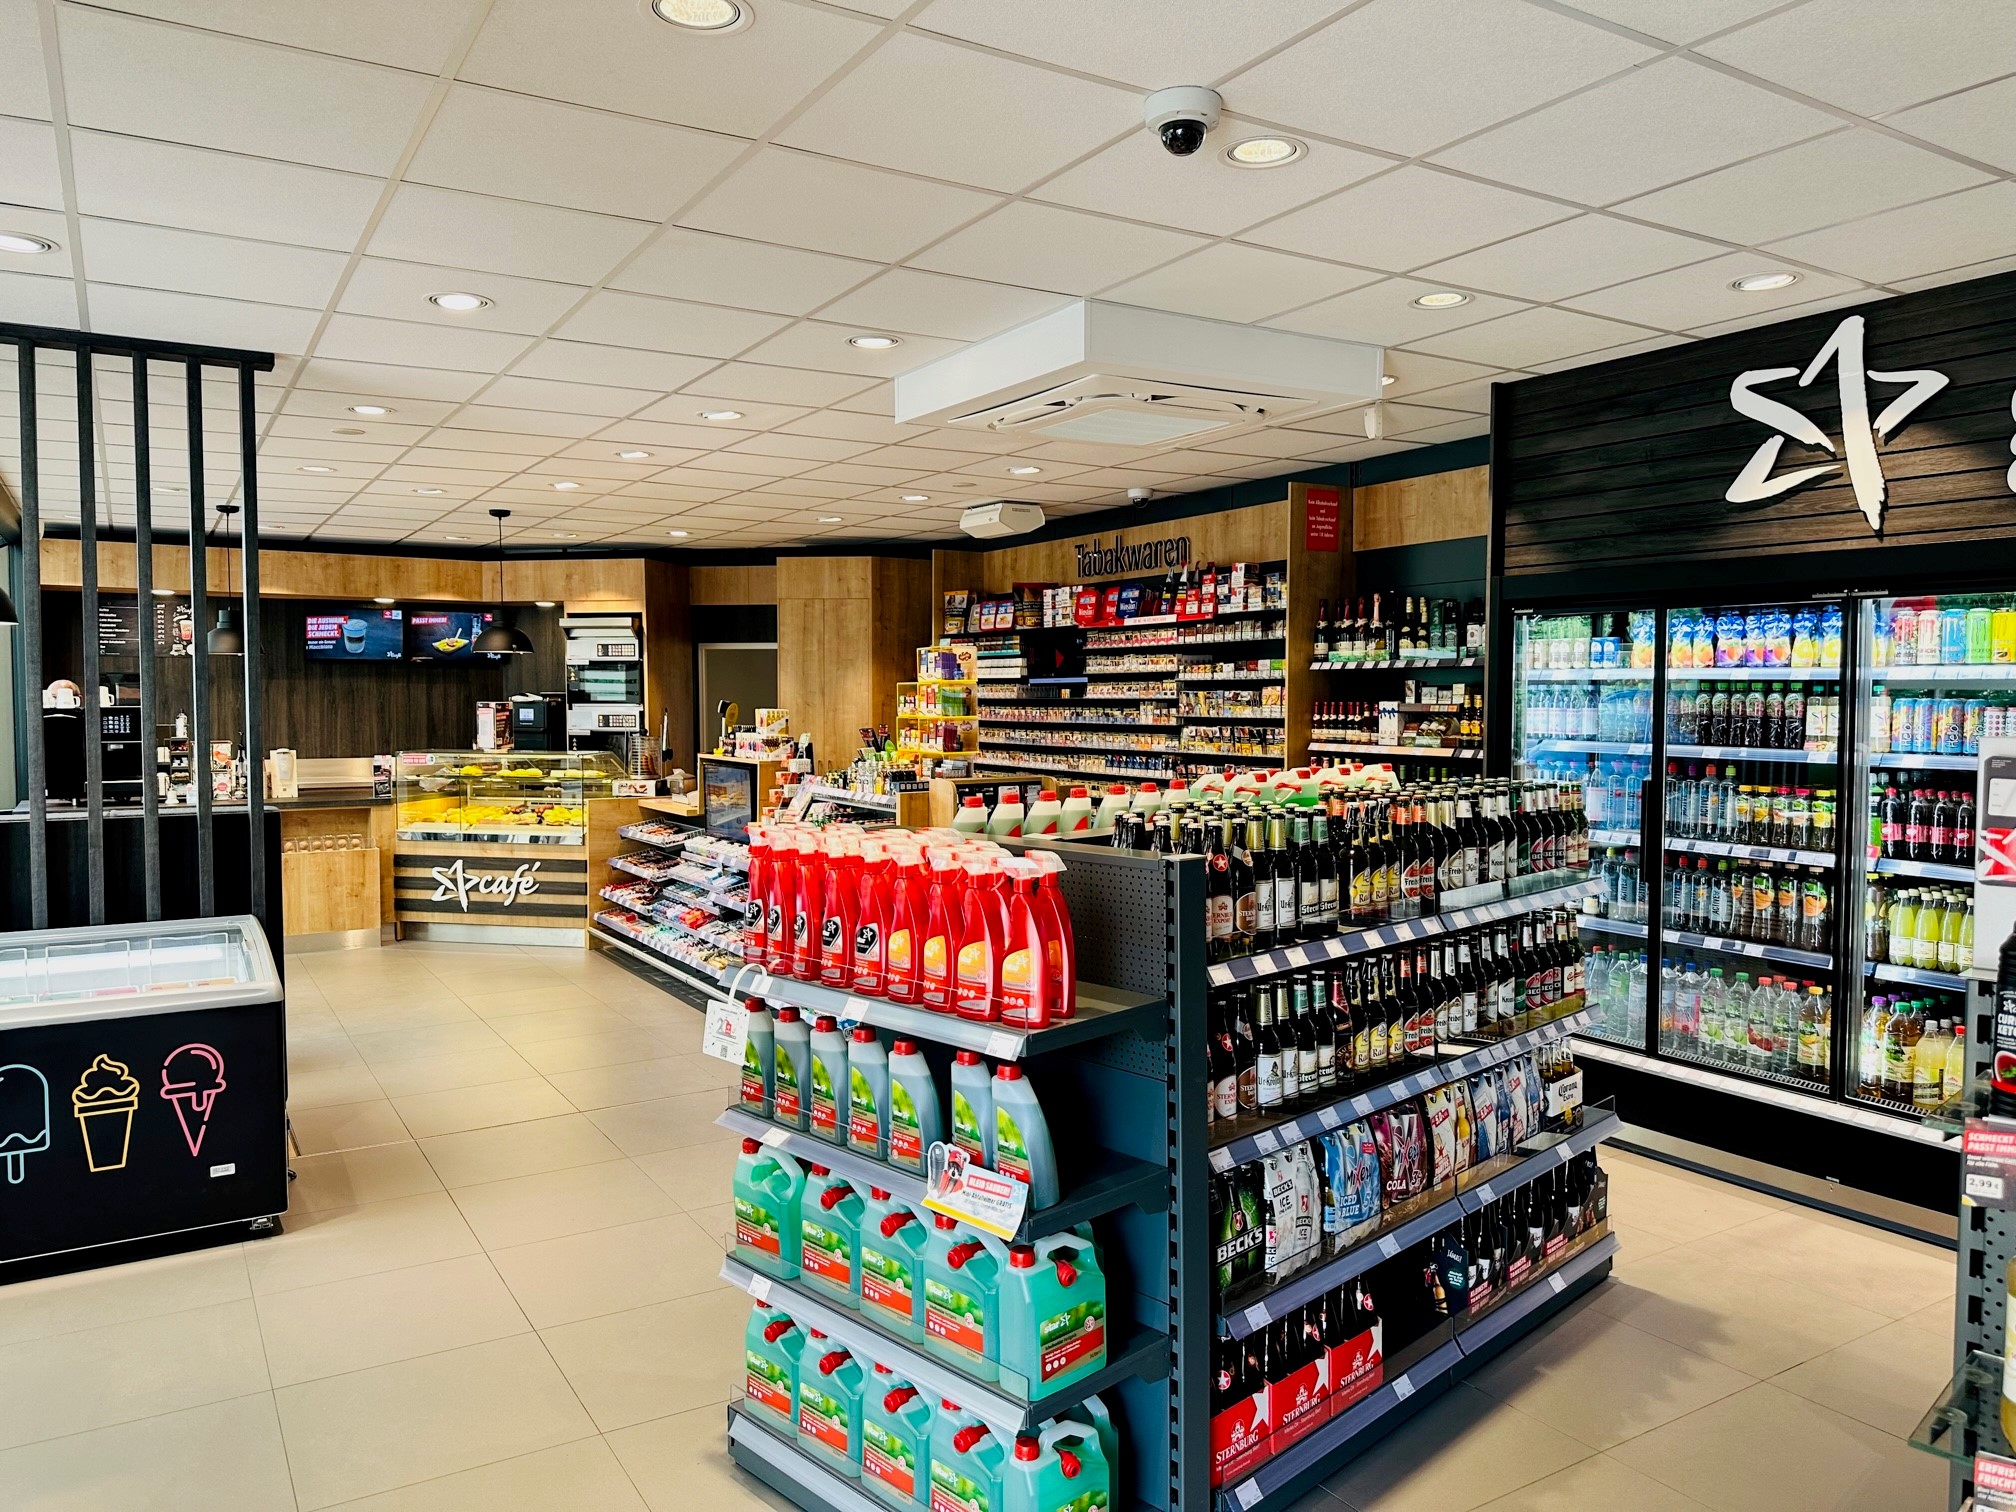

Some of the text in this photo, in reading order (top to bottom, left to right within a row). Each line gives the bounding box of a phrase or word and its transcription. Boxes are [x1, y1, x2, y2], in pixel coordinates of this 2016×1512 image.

[1075, 536, 1191, 577] Tabakwaren
[479, 861, 541, 906] café
[1559, 1081, 1577, 1097] Corona
[1967, 1141, 1995, 1151] PASST
[1968, 1132, 2014, 1144] SCHMECKT
[1386, 1180, 1406, 1190] COLA
[1279, 1195, 1291, 1208] ICE
[1340, 1194, 1357, 1207] ICED
[1342, 1204, 1360, 1218] BLUE
[1216, 1228, 1263, 1264] BECK'S
[1340, 1358, 1374, 1389] STERNBURG
[1282, 1393, 1320, 1426] STERNBURG
[1216, 1429, 1259, 1465] STERNBURG
